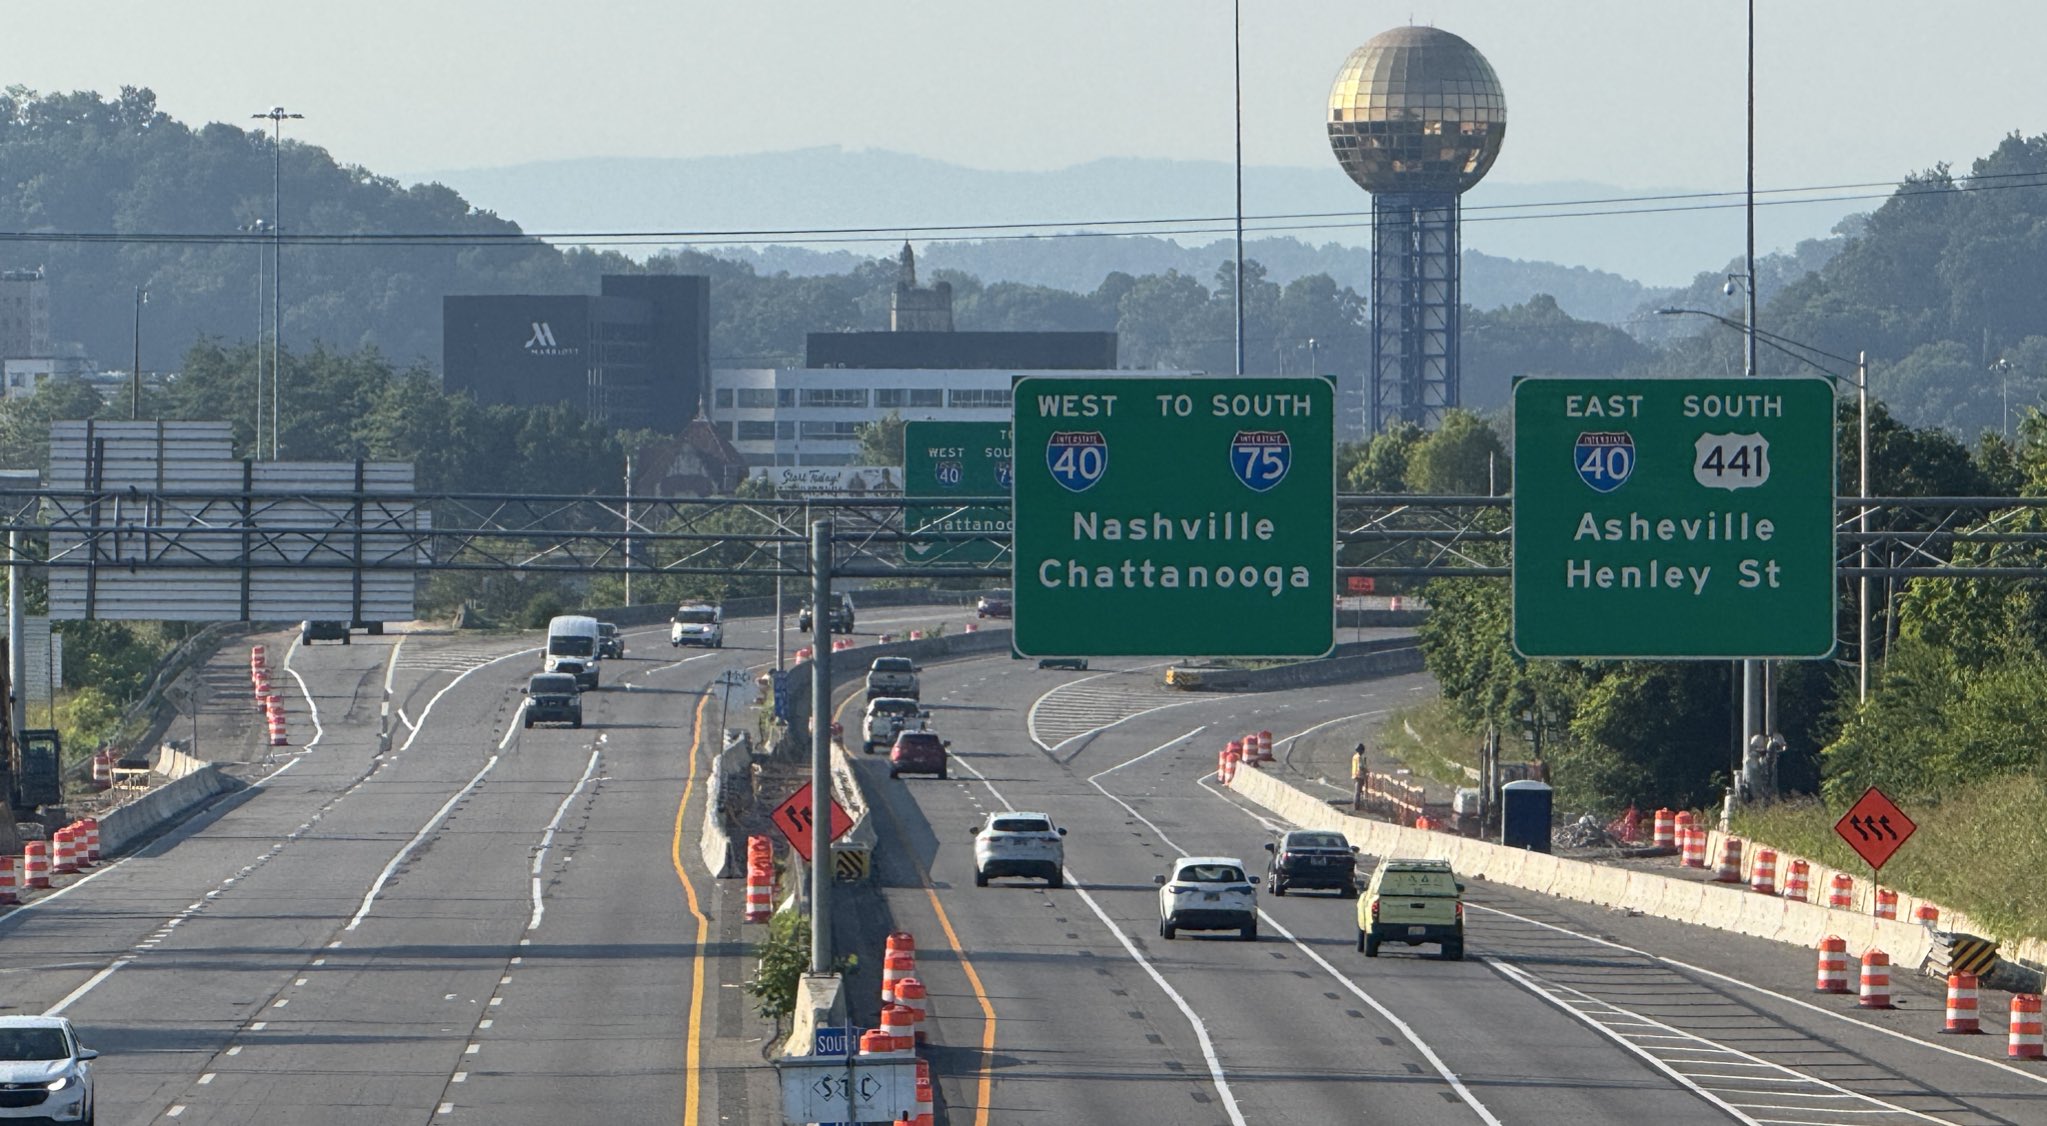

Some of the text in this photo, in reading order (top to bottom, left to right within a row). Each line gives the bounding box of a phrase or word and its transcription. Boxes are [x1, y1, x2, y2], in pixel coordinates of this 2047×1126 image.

[1038, 394, 1311, 417] WEST TO SOUTH
[1566, 395, 1782, 417] EAST SOUTH
[928, 447, 1012, 458] WEST SOU
[1056, 435, 1098, 444] INTERSTATE
[1240, 435, 1284, 444] INTERSTATE
[1584, 435, 1626, 444] INTERSTATE
[1053, 447, 1102, 480] 40
[1238, 447, 1284, 480] 75
[1580, 447, 1629, 480] 40
[1702, 445, 1763, 477] 441
[809, 469, 841, 485] Today!
[939, 468, 959, 483] 40
[1073, 511, 1275, 541] Nashville
[1573, 511, 1775, 541] Asheville
[1039, 558, 1310, 597] Chattanooga
[1567, 558, 1781, 595] Henley St
